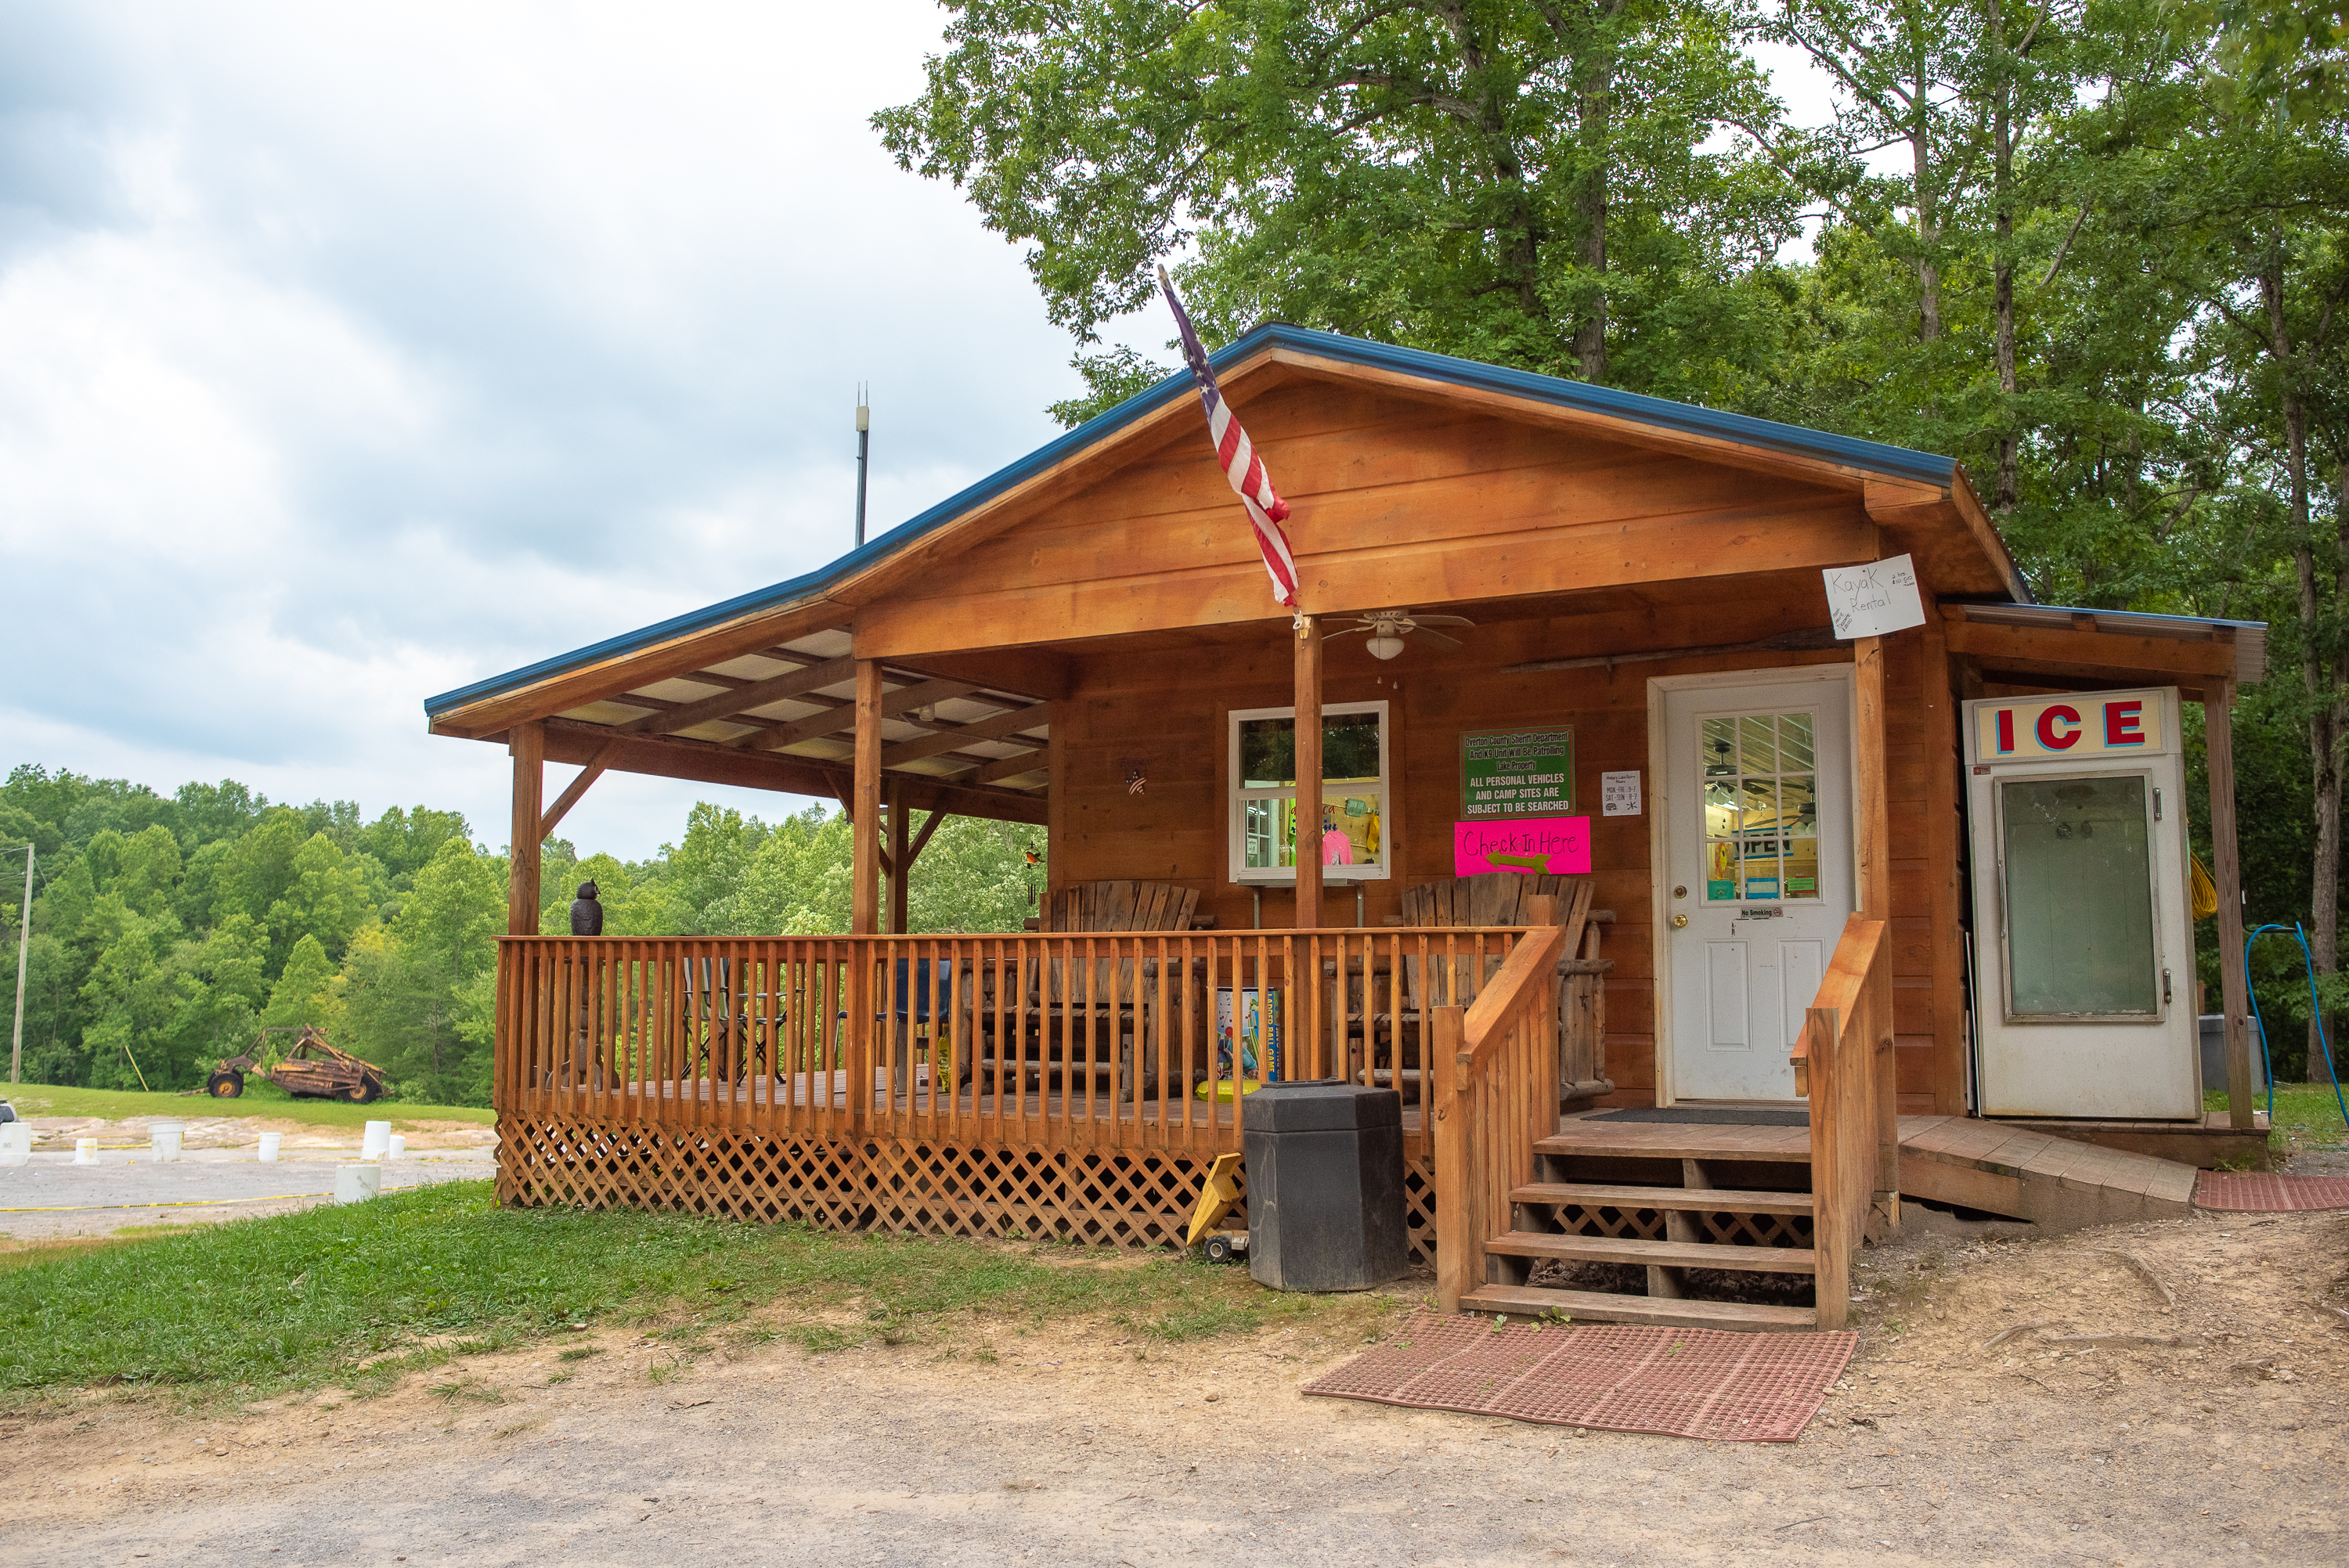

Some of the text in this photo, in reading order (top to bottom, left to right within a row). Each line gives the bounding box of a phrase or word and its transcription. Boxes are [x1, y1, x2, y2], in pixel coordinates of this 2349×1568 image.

[1849, 589, 1892, 613] Rental
[1994, 701, 2145, 755] ICE
[1465, 732, 1568, 747] Overton County Sheriff Department
[1470, 745, 1564, 759] And K9 Unit Will Be Patrolling
[1496, 760, 1536, 771] Lake Property
[1470, 773, 1564, 788] ALL PERSONAL VEHICLES
[1475, 787, 1560, 801] AND CAMP SITES ARE
[1467, 800, 1568, 814] SUBJECT TO BE SEARCHED
[1463, 831, 1579, 856] Check In Here
[1736, 831, 1791, 855] OPEN
